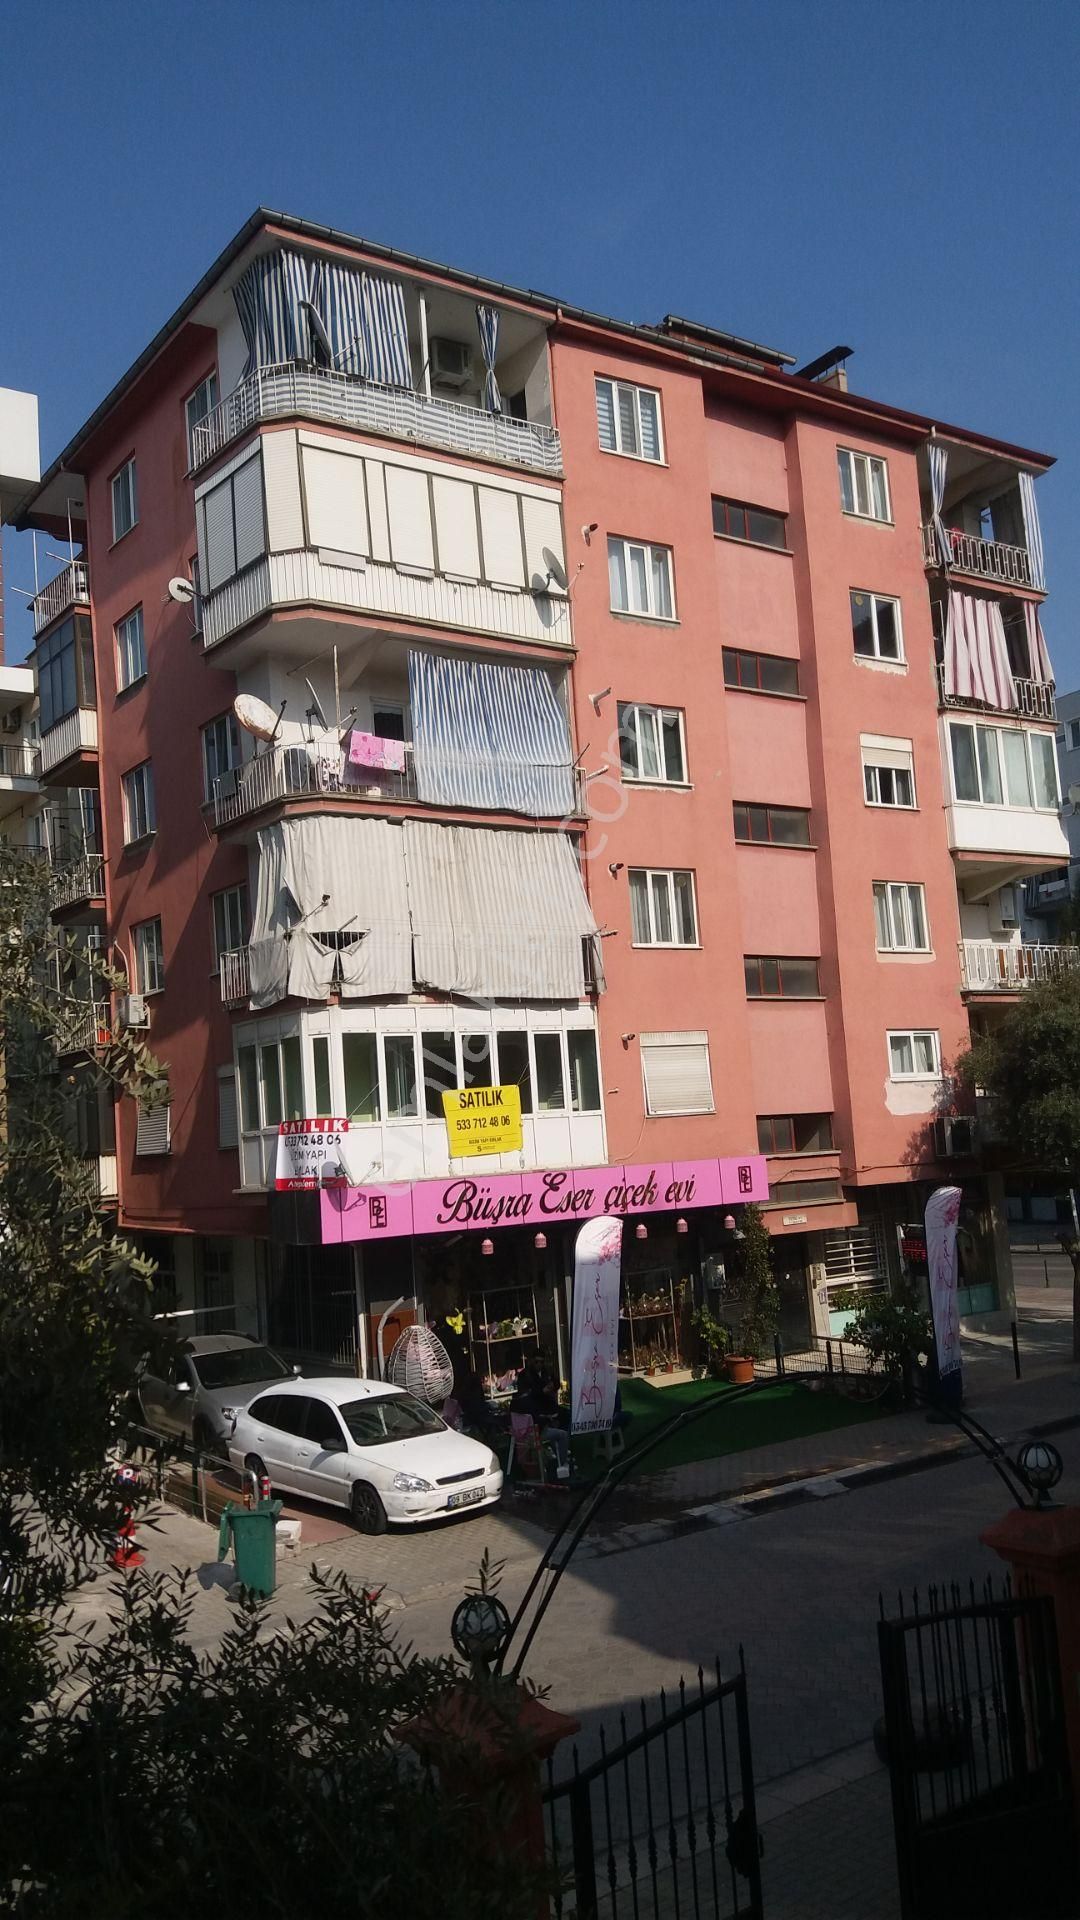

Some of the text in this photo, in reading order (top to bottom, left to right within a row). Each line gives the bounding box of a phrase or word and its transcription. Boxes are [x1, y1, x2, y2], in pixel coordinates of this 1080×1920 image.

[459, 1089, 504, 1109] SATILIK
[283, 1119, 345, 1133] SATILIK
[456, 1115, 511, 1131] 533 712 48 06
[310, 1134, 324, 1146] 48
[305, 1149, 327, 1160] YAPI
[436, 1169, 697, 1225] Büşra Eser çiçek evi
[462, 1492, 472, 1501] BK
